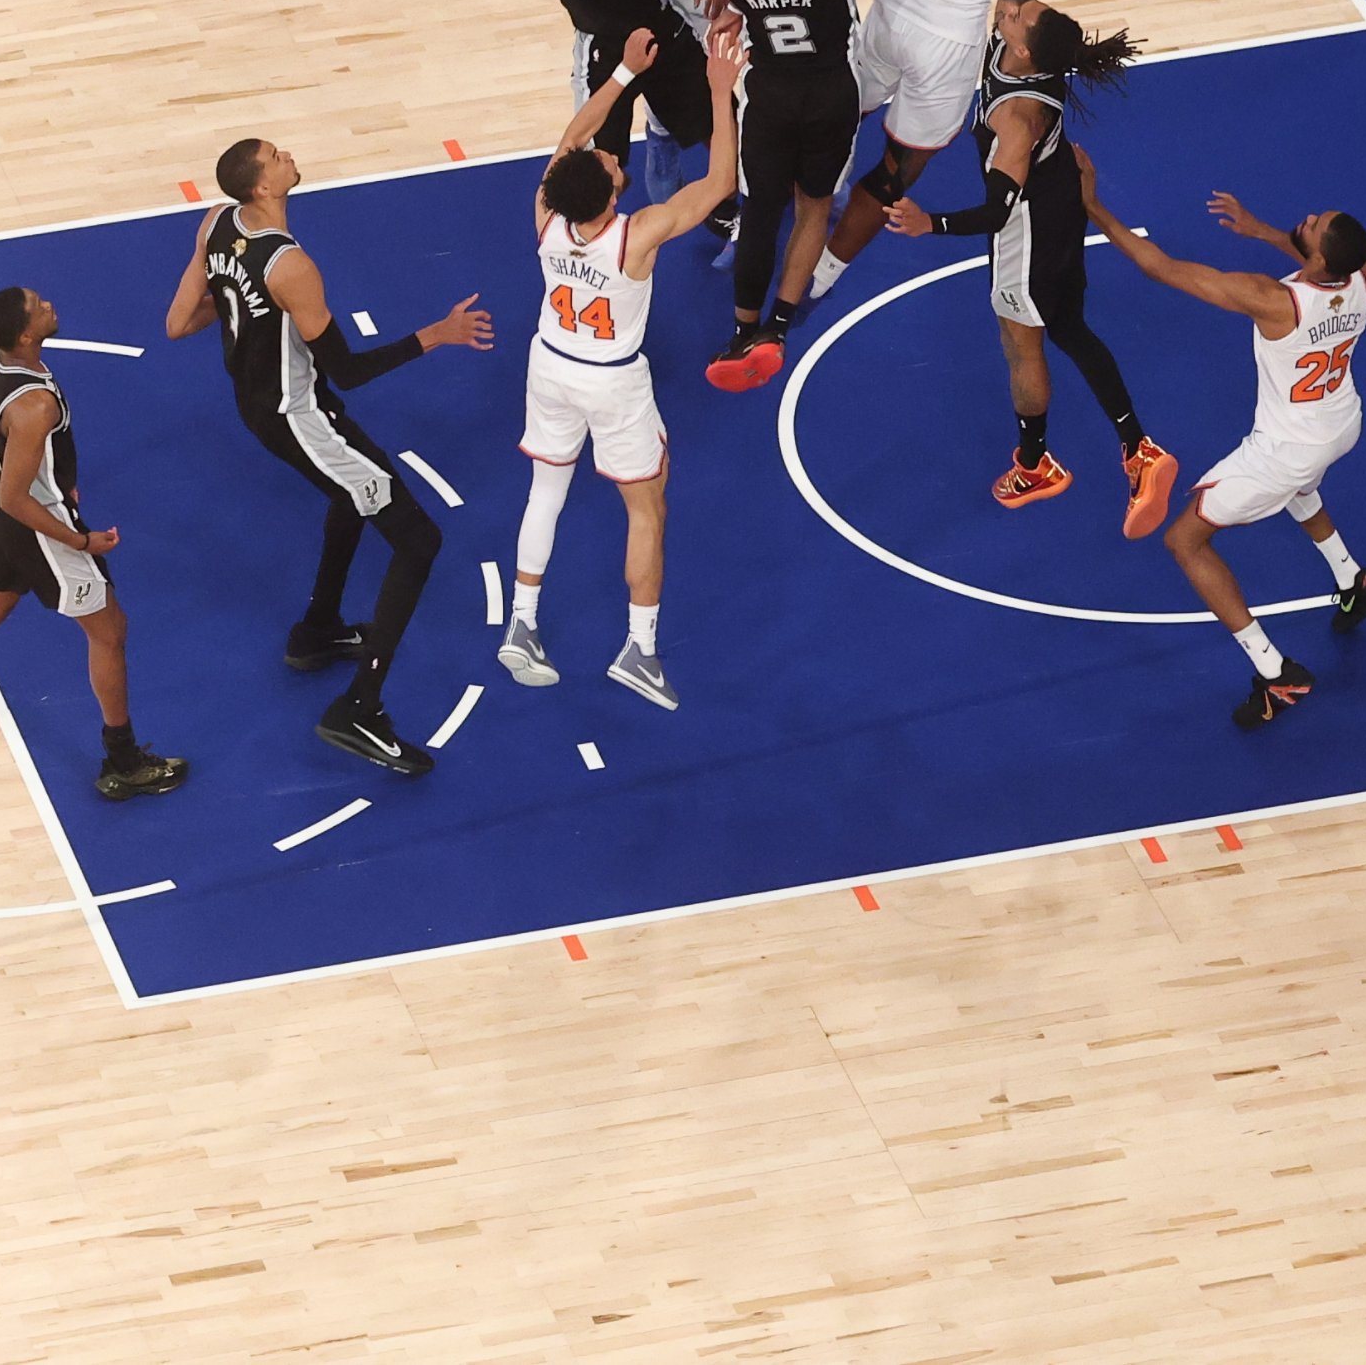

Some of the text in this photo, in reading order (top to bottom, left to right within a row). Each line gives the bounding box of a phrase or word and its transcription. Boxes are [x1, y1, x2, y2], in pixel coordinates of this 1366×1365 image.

[763, 13, 818, 55] 2
[549, 256, 610, 291] SHAMET
[549, 283, 616, 341] 44
[1308, 312, 1362, 345] BRIDGES
[1290, 334, 1358, 403] 25
